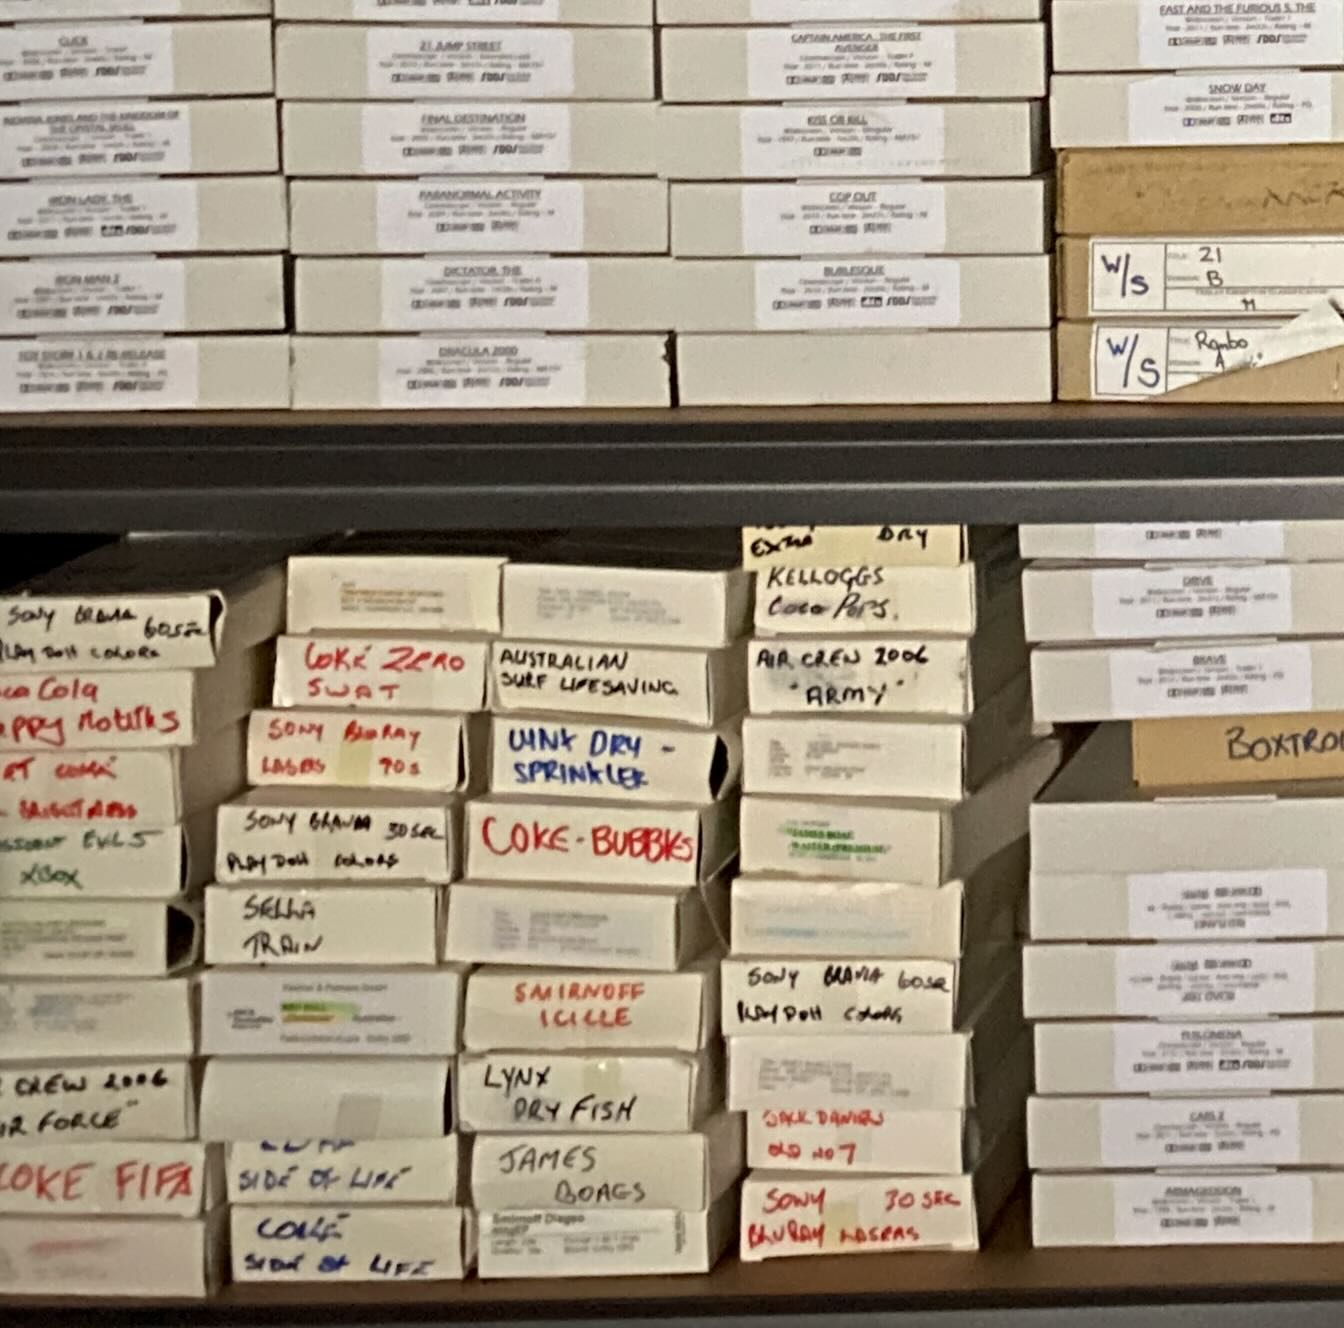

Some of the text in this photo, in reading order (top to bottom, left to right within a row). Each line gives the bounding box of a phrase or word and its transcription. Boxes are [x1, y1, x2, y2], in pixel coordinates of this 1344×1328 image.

[1234, 3, 1279, 13] FURIOUS
[1208, 83, 1266, 93] SNOW DAY
[1199, 247, 1222, 264] 21
[1101, 253, 1150, 297] W/S
[1207, 272, 1223, 286] B
[1107, 336, 1160, 389] W/S
[877, 528, 928, 548] DRY
[767, 568, 884, 590] KELLOGGS
[381, 647, 465, 672] ZERO
[500, 650, 628, 670] AUSTRALIAN
[757, 648, 793, 668] AIR
[876, 647, 929, 666] 2006
[308, 682, 400, 699] SWAT
[502, 673, 548, 690] SURF
[269, 721, 325, 740] SONY
[589, 733, 642, 757] DRY
[245, 812, 297, 830] SONY
[243, 935, 323, 957] TRAIN
[748, 968, 799, 988] SONY
[515, 982, 646, 1002] SMIRNOFF
[484, 1066, 552, 1089] LYNX
[513, 1095, 637, 1122] DRY FISH
[499, 1146, 598, 1174] JAMES
[116, 1162, 192, 1200] FIFA
[763, 1189, 961, 1213] SONY 30 SEC
